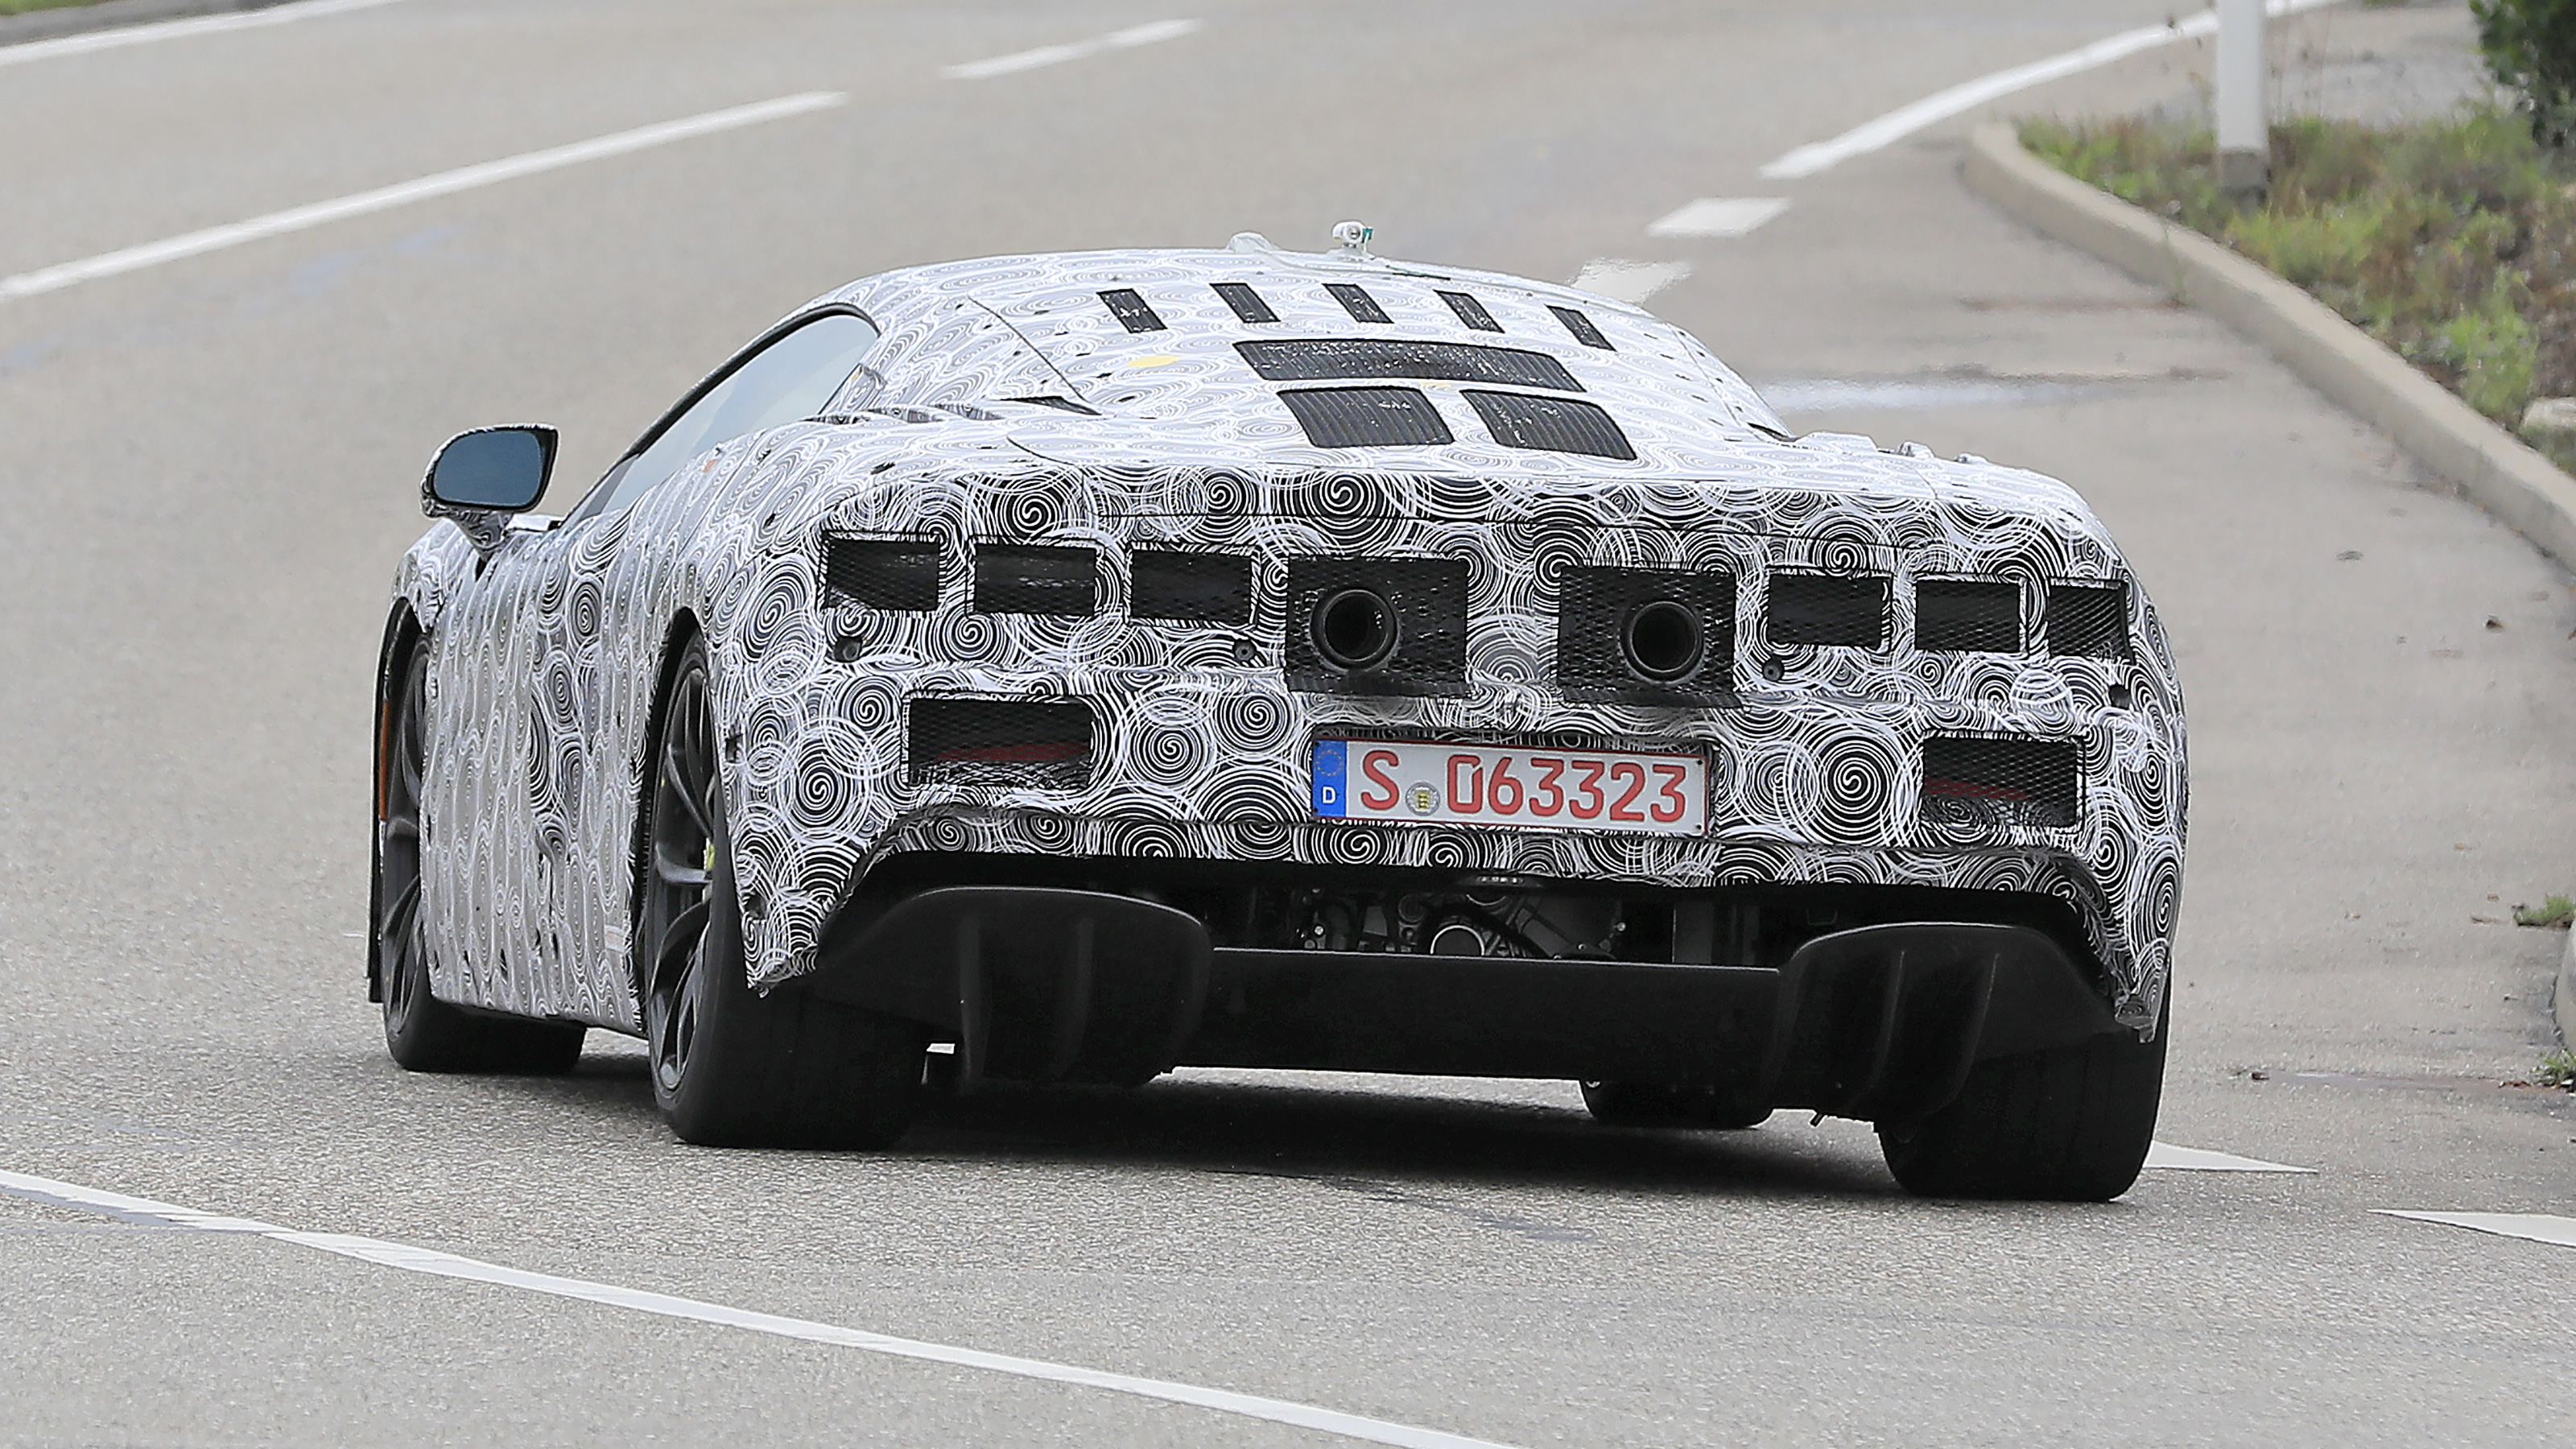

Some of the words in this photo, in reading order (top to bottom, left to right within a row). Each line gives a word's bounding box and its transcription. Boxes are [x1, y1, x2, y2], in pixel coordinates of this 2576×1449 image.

[1322, 786, 1336, 804] D
[1361, 750, 1399, 810] S
[1447, 754, 1686, 823] 063323
